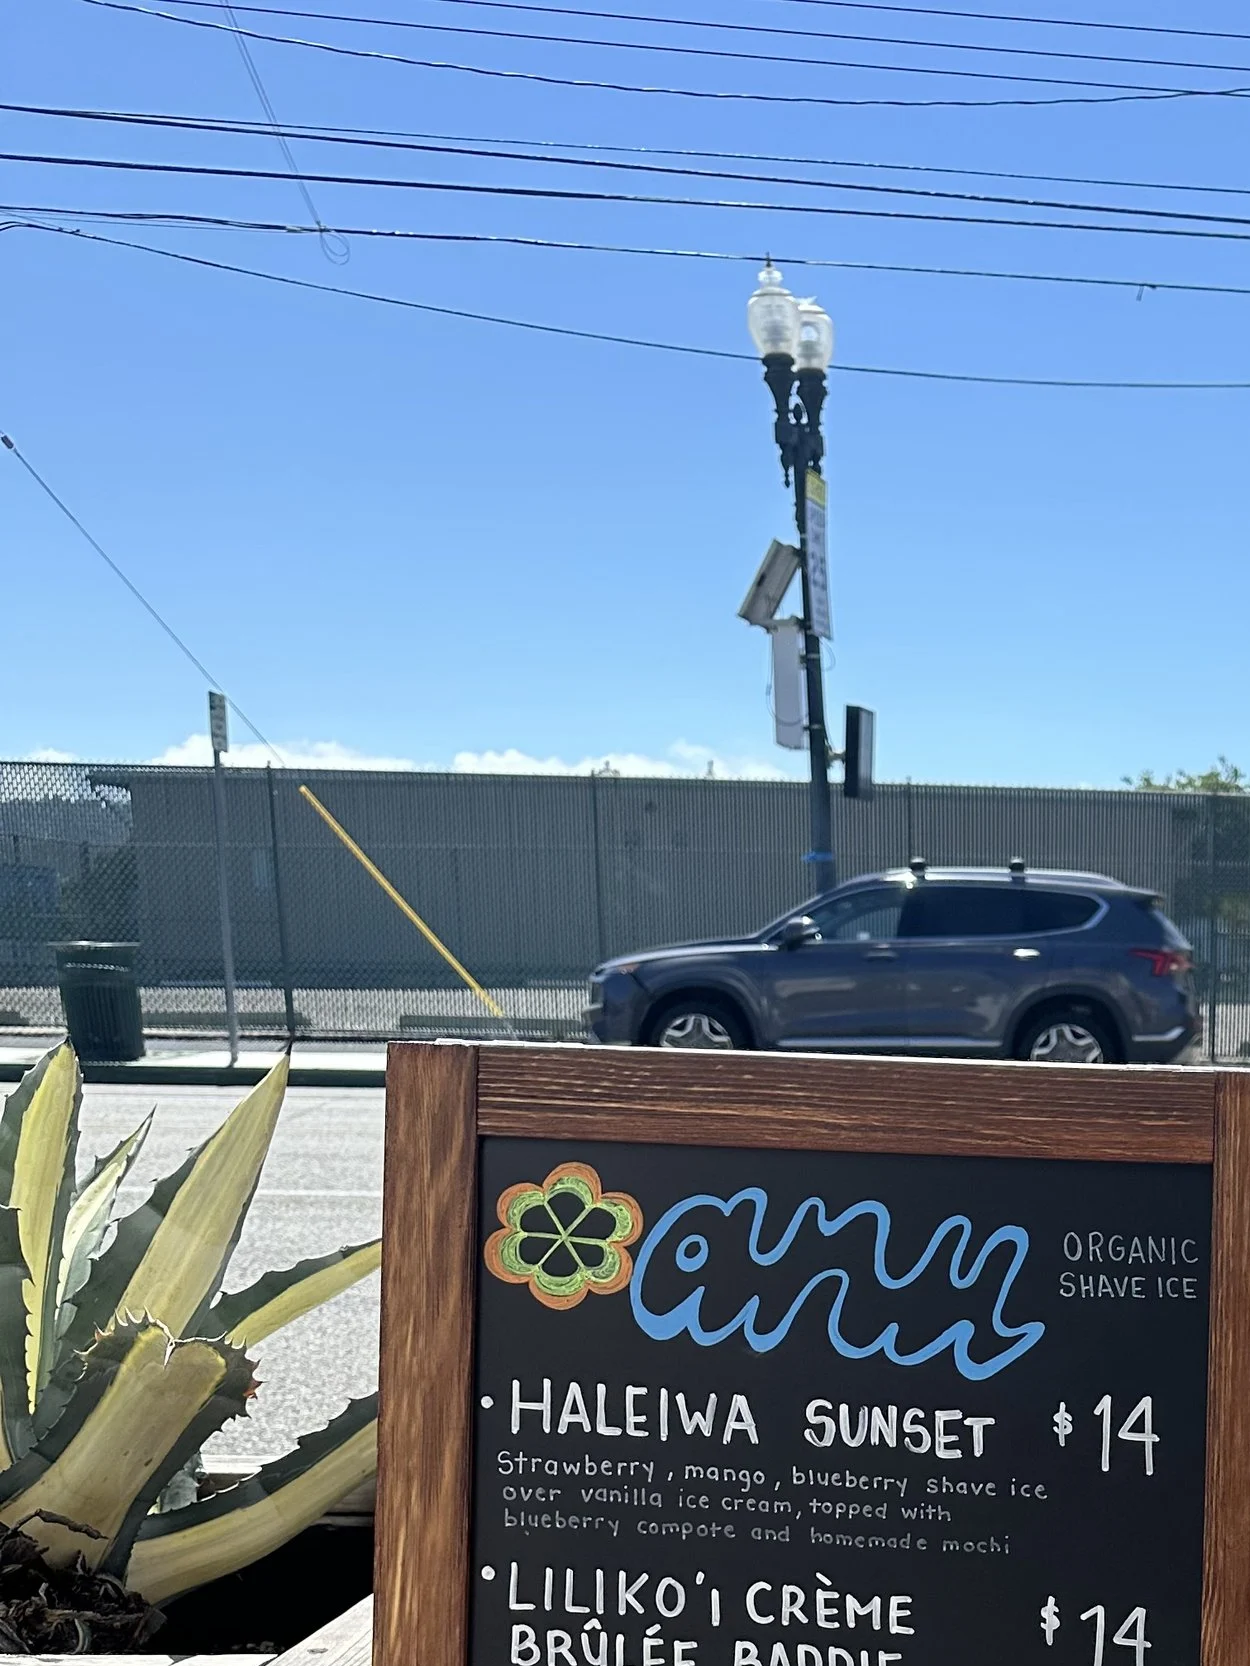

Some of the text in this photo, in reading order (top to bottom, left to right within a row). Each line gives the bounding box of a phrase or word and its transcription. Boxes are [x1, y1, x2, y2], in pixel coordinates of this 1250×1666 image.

[1064, 1232, 1198, 1265] ORGANIC
[1060, 1272, 1197, 1298] SHAVE ICE
[512, 1378, 758, 1444] HALEIWA
[804, 1399, 995, 1458] SUNSET
[685, 1466, 780, 1492] mango,
[793, 1466, 907, 1497] blueberry
[927, 1476, 996, 1496] shave
[1011, 1478, 1047, 1499] ice
[503, 1485, 951, 1521] over vanilla ice cream, topped with
[505, 1508, 1008, 1554] blueberry compote and homemade mochi
[745, 1571, 915, 1635] CRÈME
